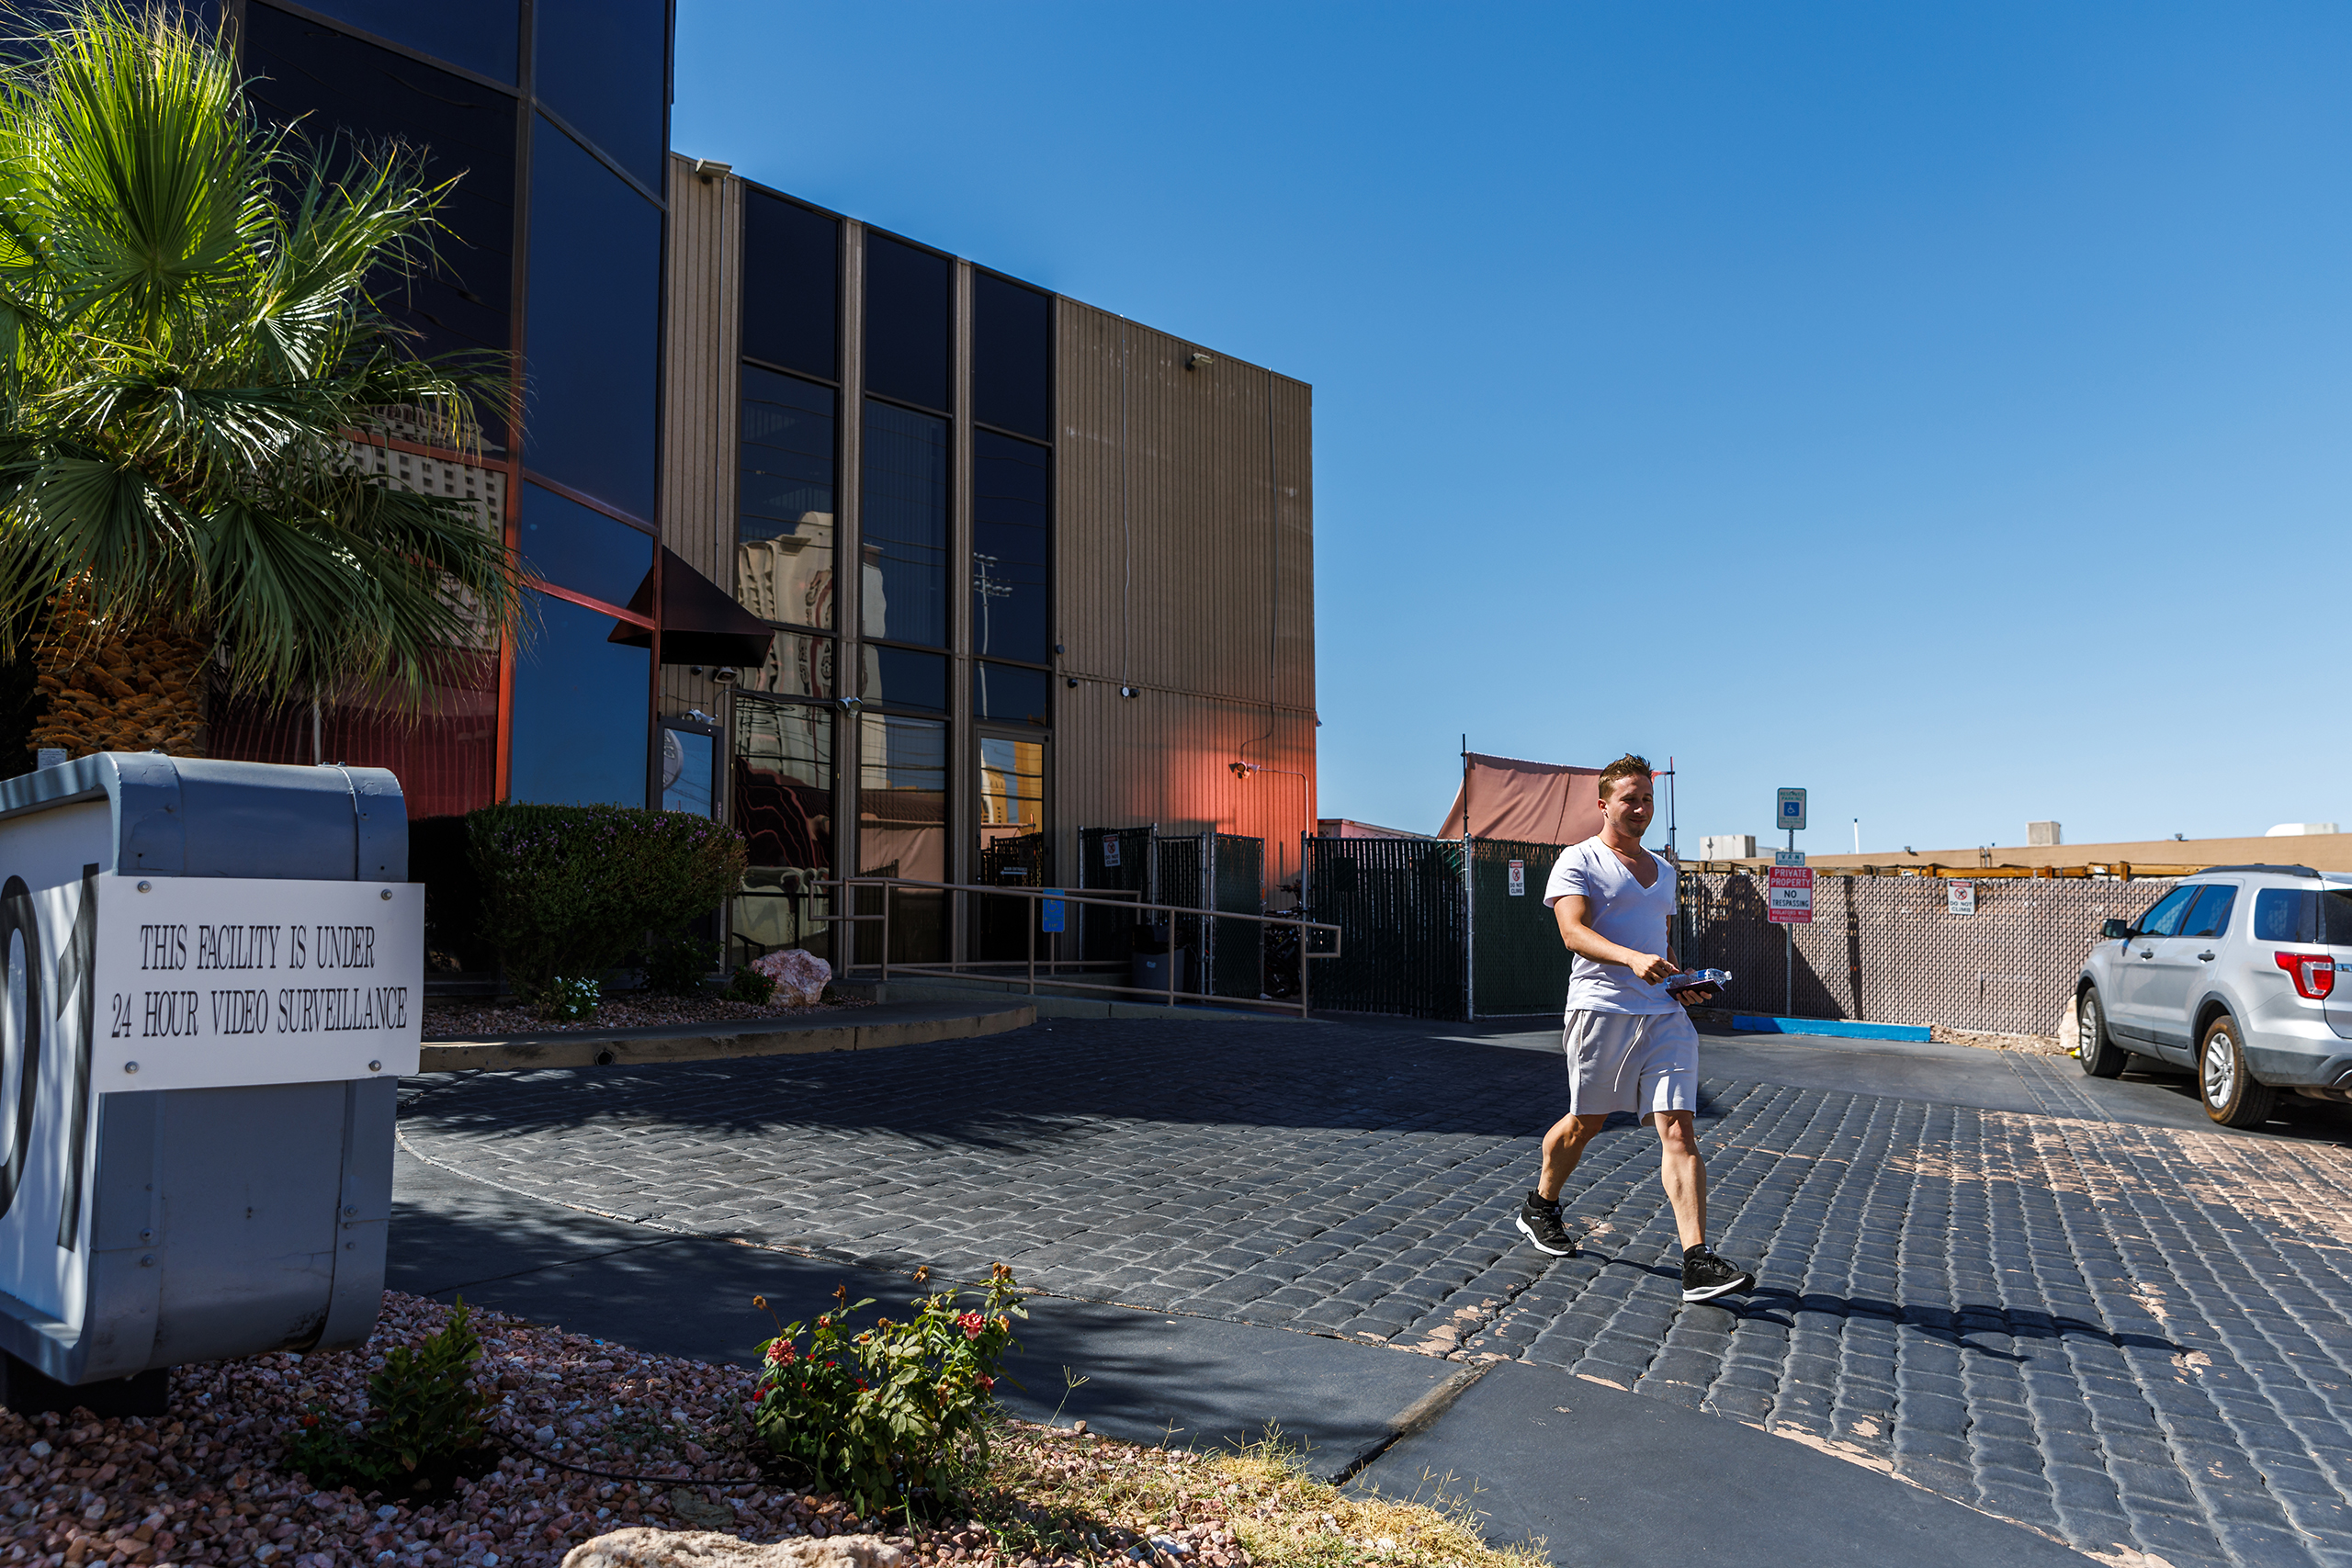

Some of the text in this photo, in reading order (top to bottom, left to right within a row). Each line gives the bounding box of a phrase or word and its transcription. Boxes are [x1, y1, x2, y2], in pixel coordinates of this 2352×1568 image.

[1774, 868, 1807, 878] PRIVATE
[1770, 877, 1811, 887] PROPERTY
[1783, 889, 1797, 898] NO
[1772, 898, 1809, 908] TRESPASSING
[140, 924, 376, 970] THIS FACILITY IS UNDER
[111, 986, 408, 1039] 24 HOUR VIDEO SURVEILLANCE
